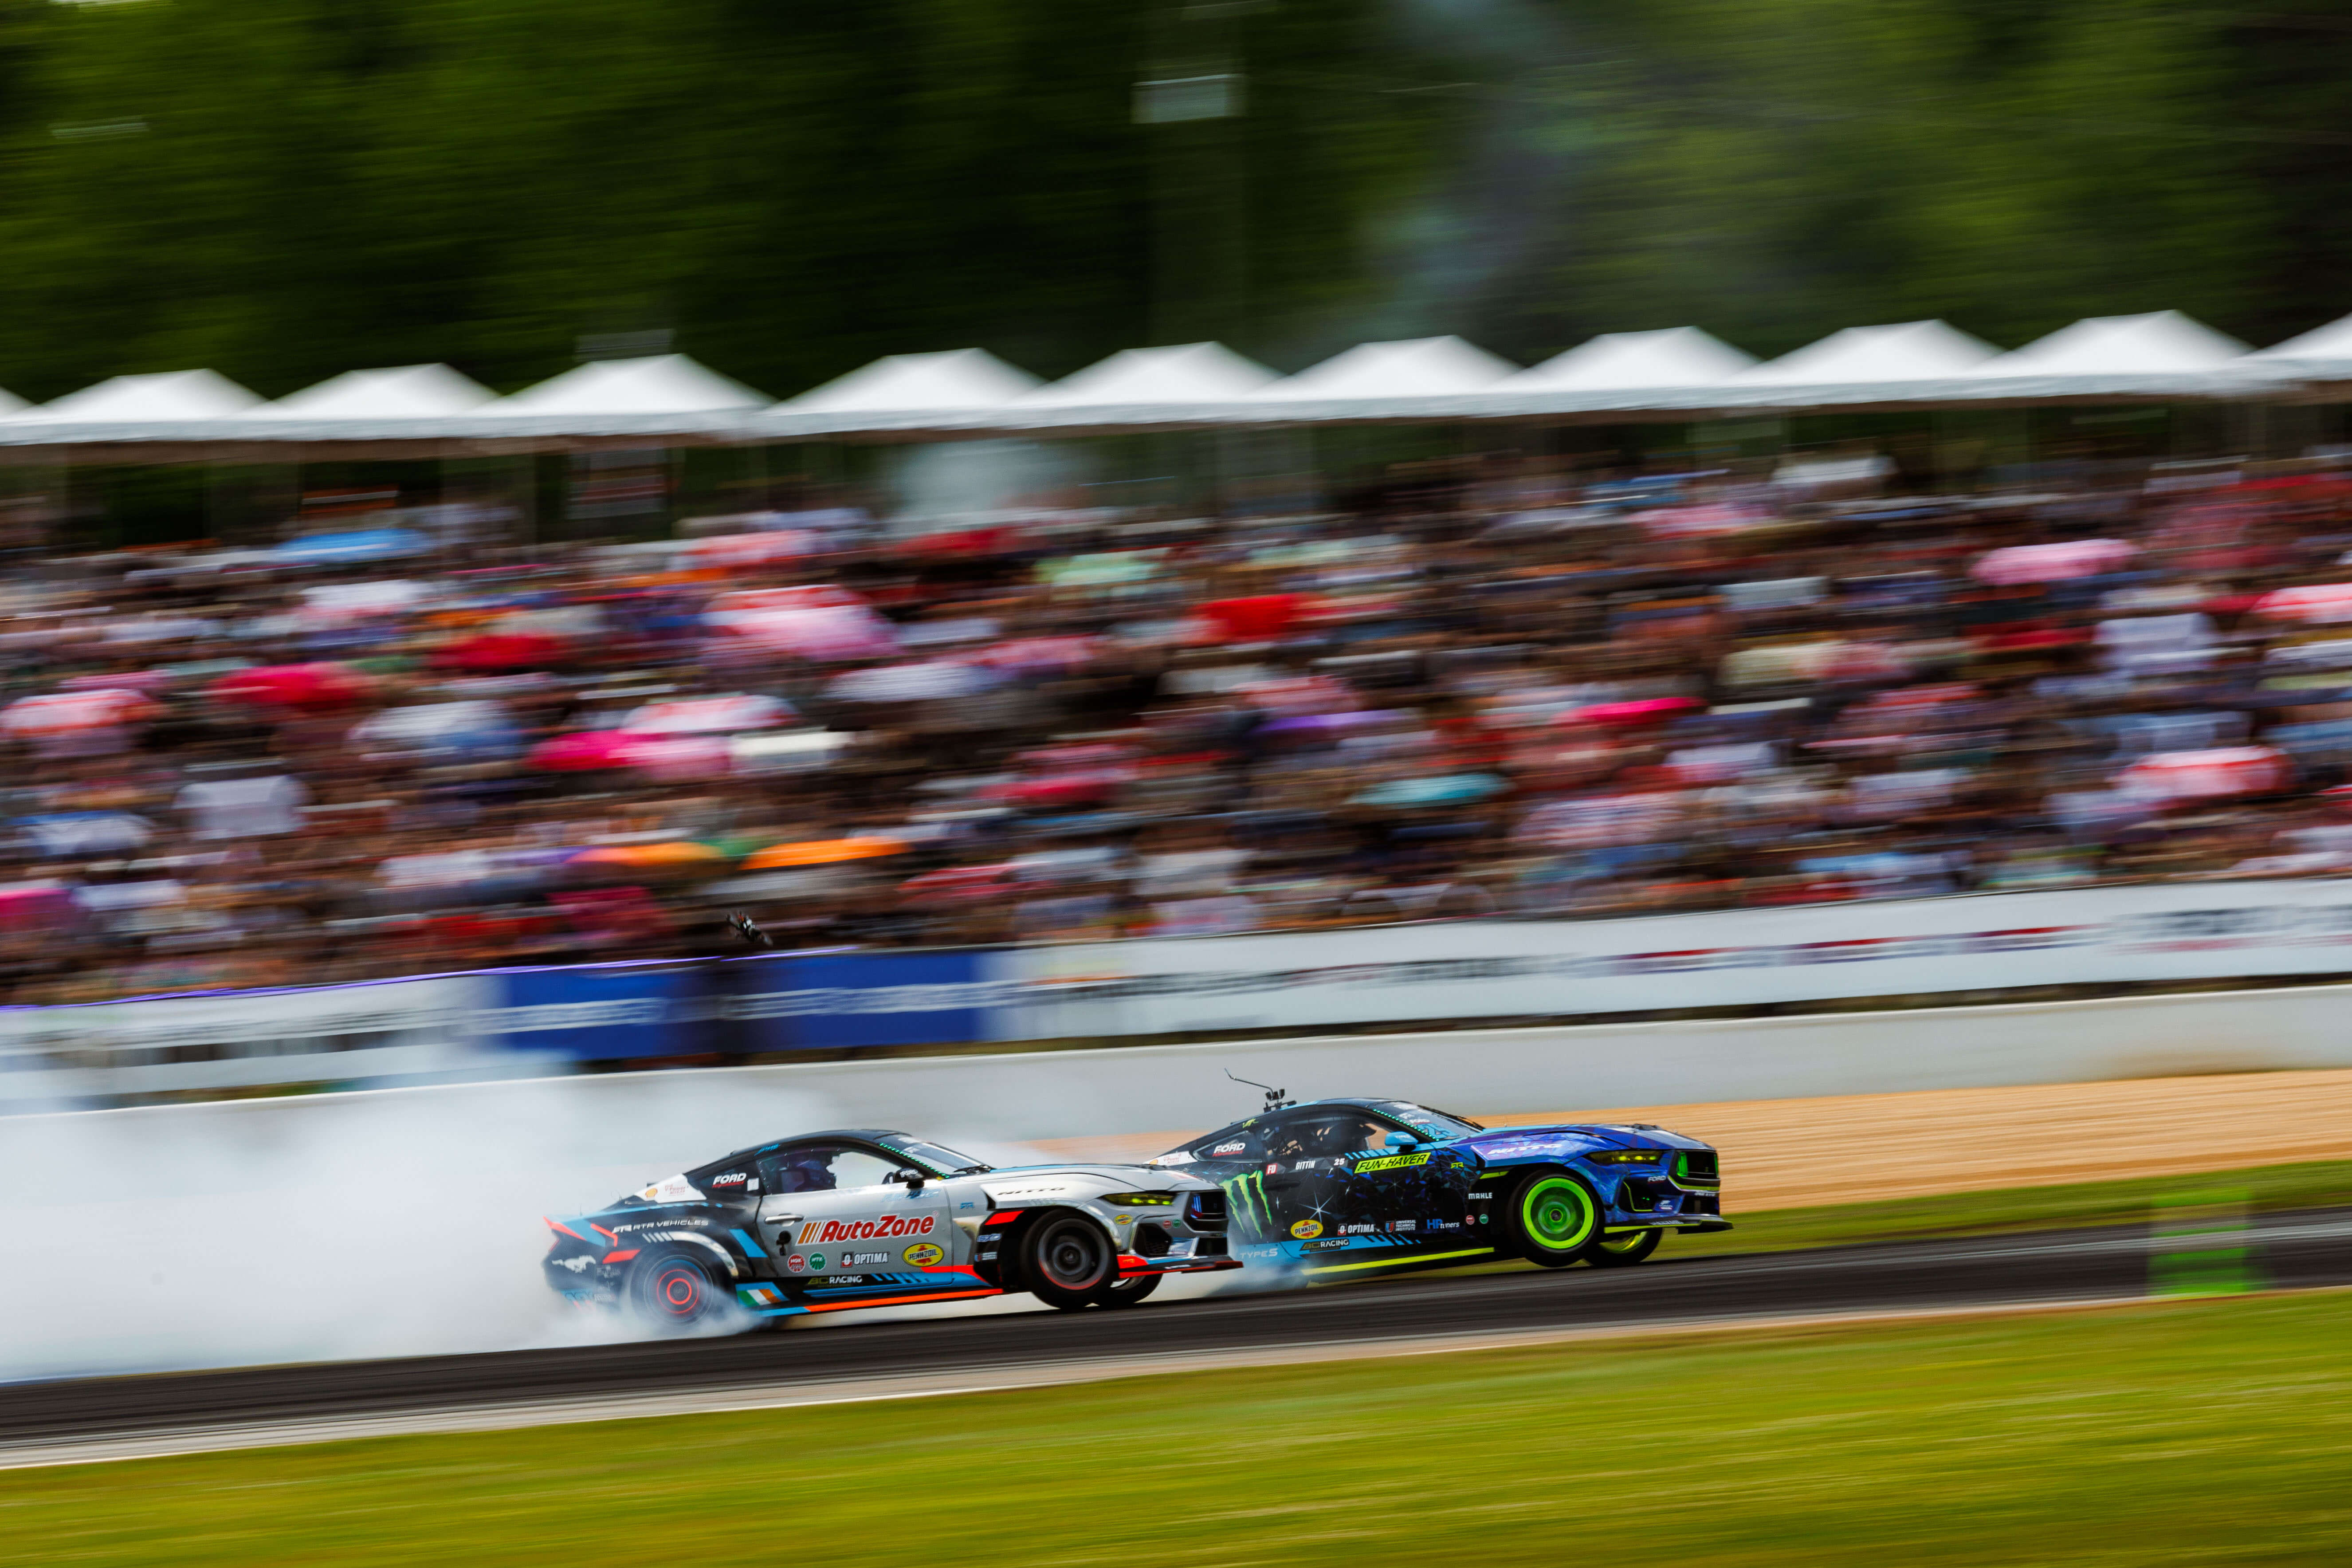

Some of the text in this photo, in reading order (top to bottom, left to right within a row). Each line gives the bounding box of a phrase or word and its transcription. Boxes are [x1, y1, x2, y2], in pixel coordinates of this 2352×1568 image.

[1213, 1143, 1246, 1154] FORD
[1295, 1160, 1316, 1170] GITTIN
[1359, 1155, 1425, 1170] FUN-HAVER
[1267, 1164, 1276, 1174] FD
[713, 1172, 747, 1185] FORD
[633, 1222, 654, 1230] RTR
[656, 1219, 709, 1227] VEHICLES
[819, 1214, 935, 1243] AutoZone
[1347, 1224, 1375, 1234] OPTIMA
[1427, 1218, 1443, 1229] HP
[1295, 1224, 1319, 1235] PENNZOIL
[1320, 1239, 1349, 1248] RACING
[854, 1252, 888, 1265] OPTIMA
[829, 1275, 863, 1285] RACING
